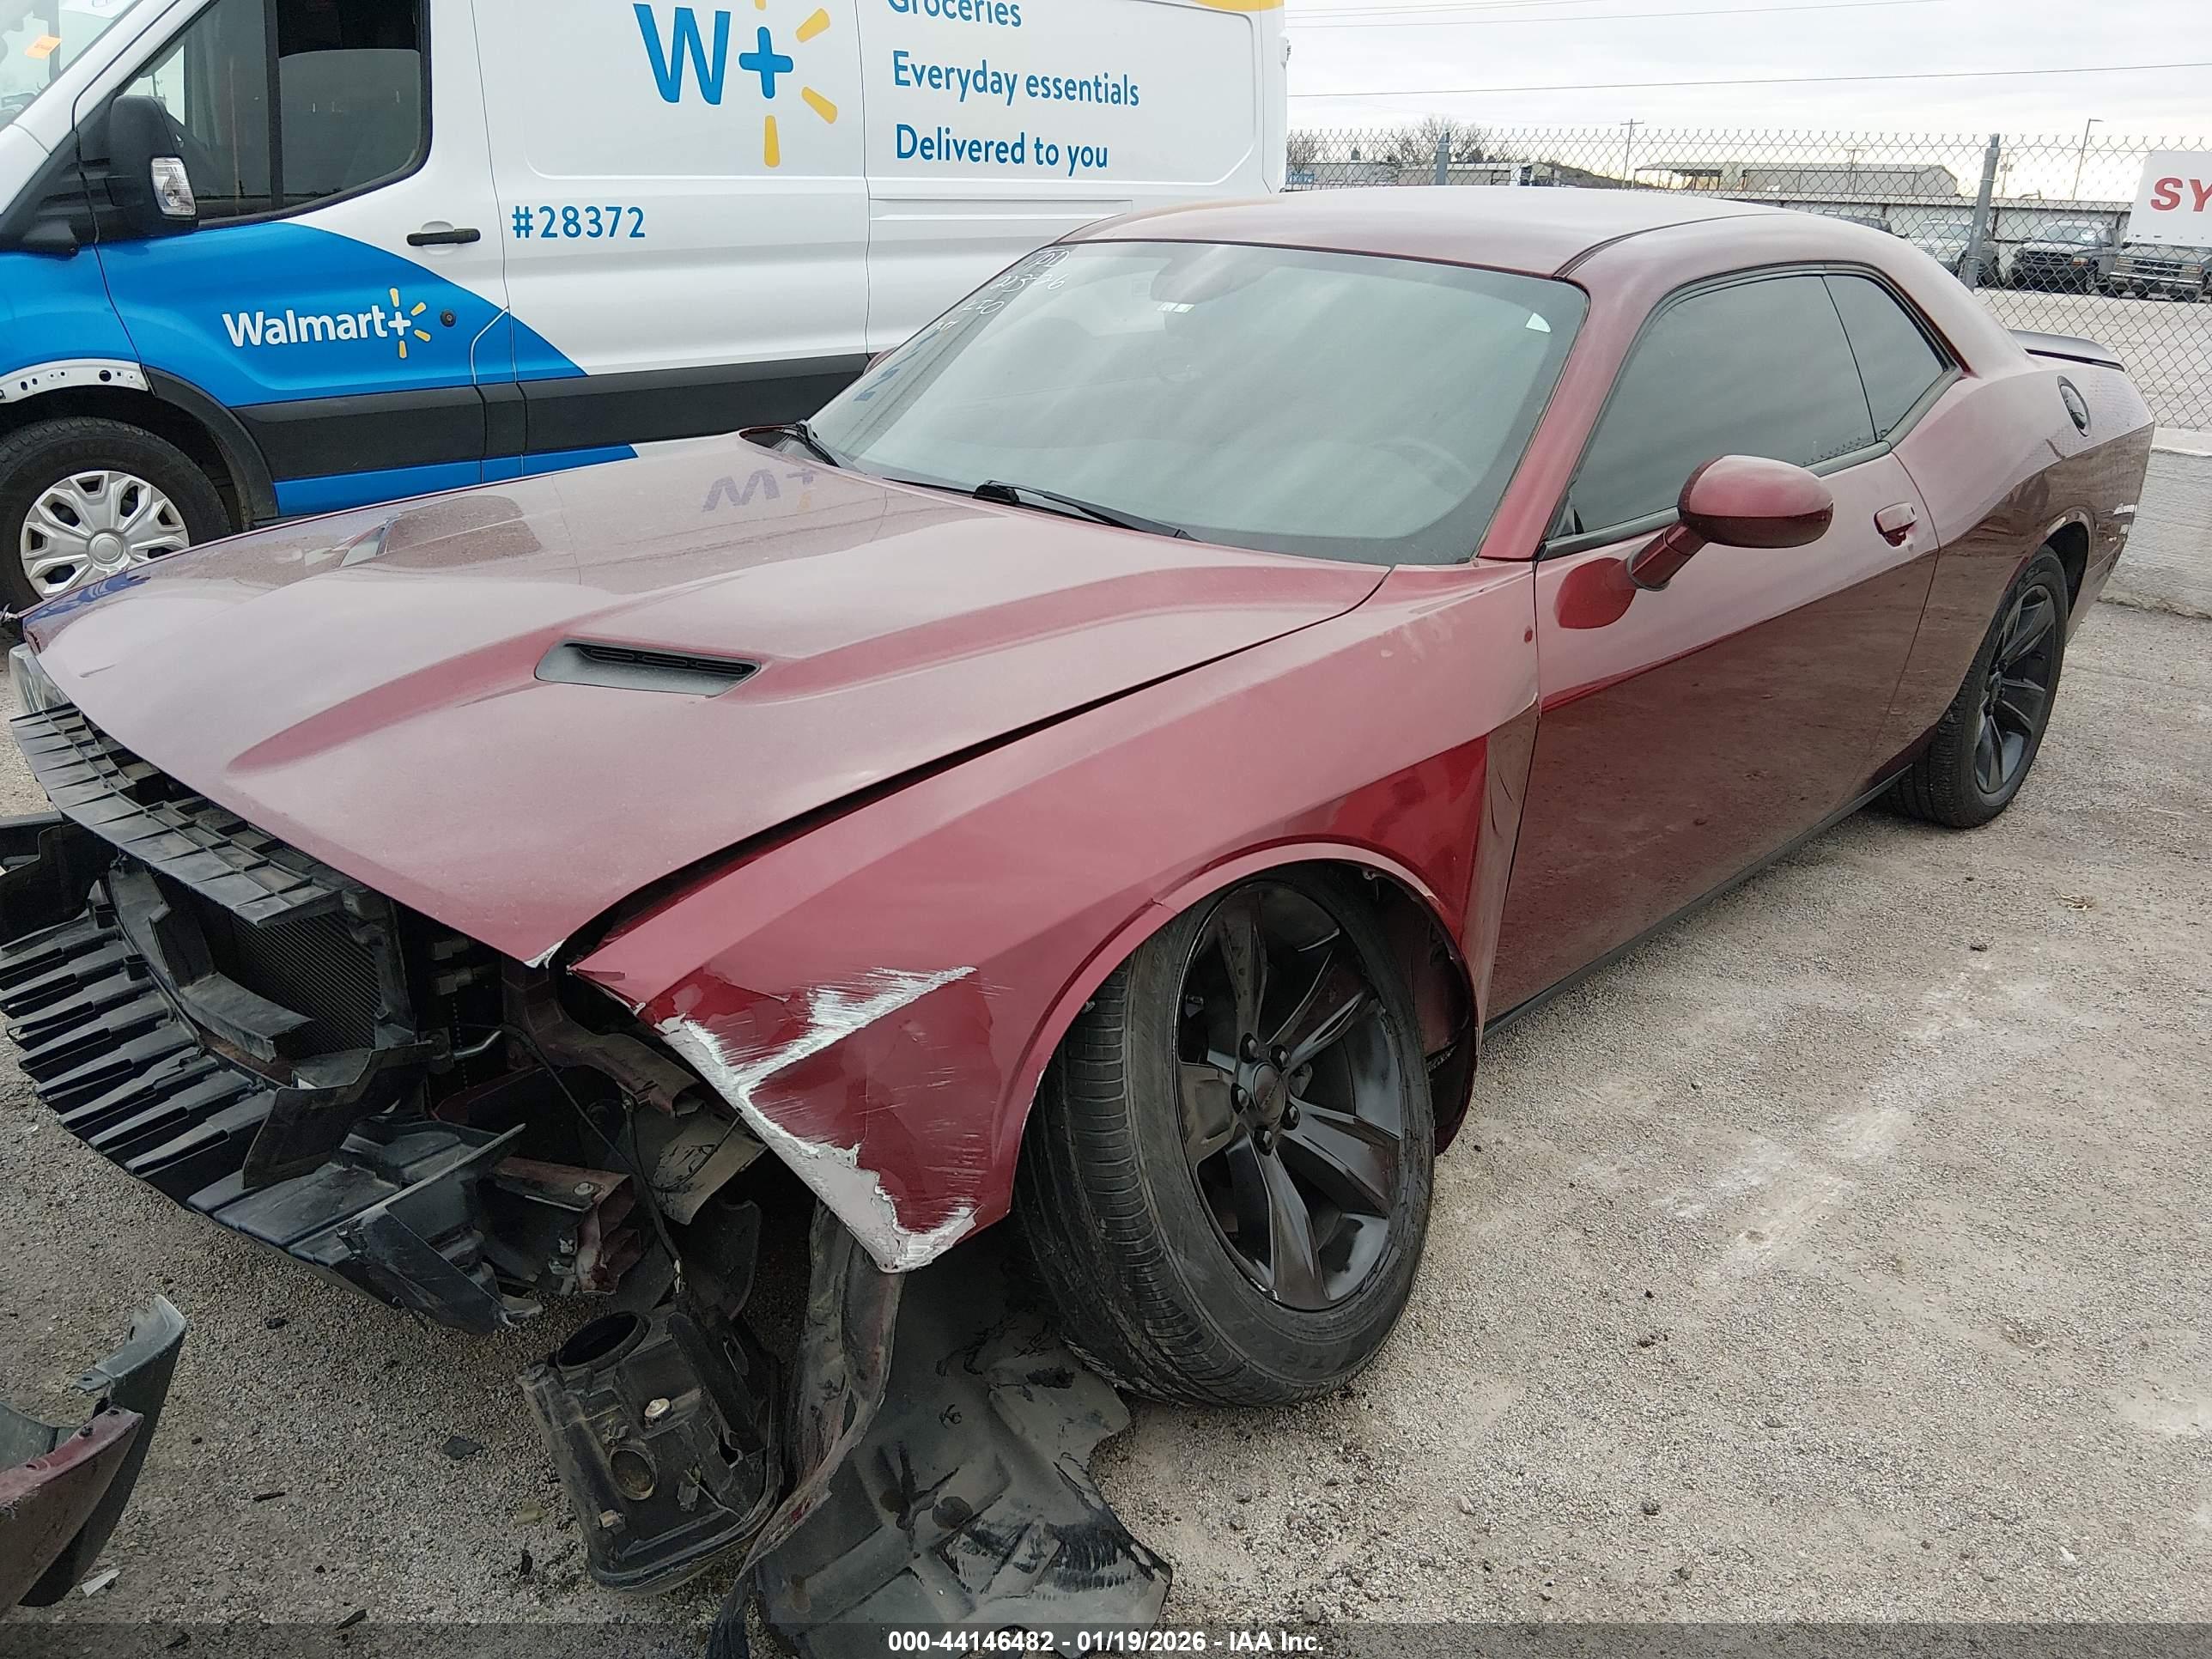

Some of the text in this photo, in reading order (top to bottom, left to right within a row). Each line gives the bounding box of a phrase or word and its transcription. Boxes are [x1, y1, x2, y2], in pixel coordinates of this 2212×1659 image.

[892, 50, 1139, 106] Everyday essentials
[896, 123, 1108, 177] Delivered to you
[512, 205, 646, 239] #28372
[222, 305, 411, 347] Walmart+
